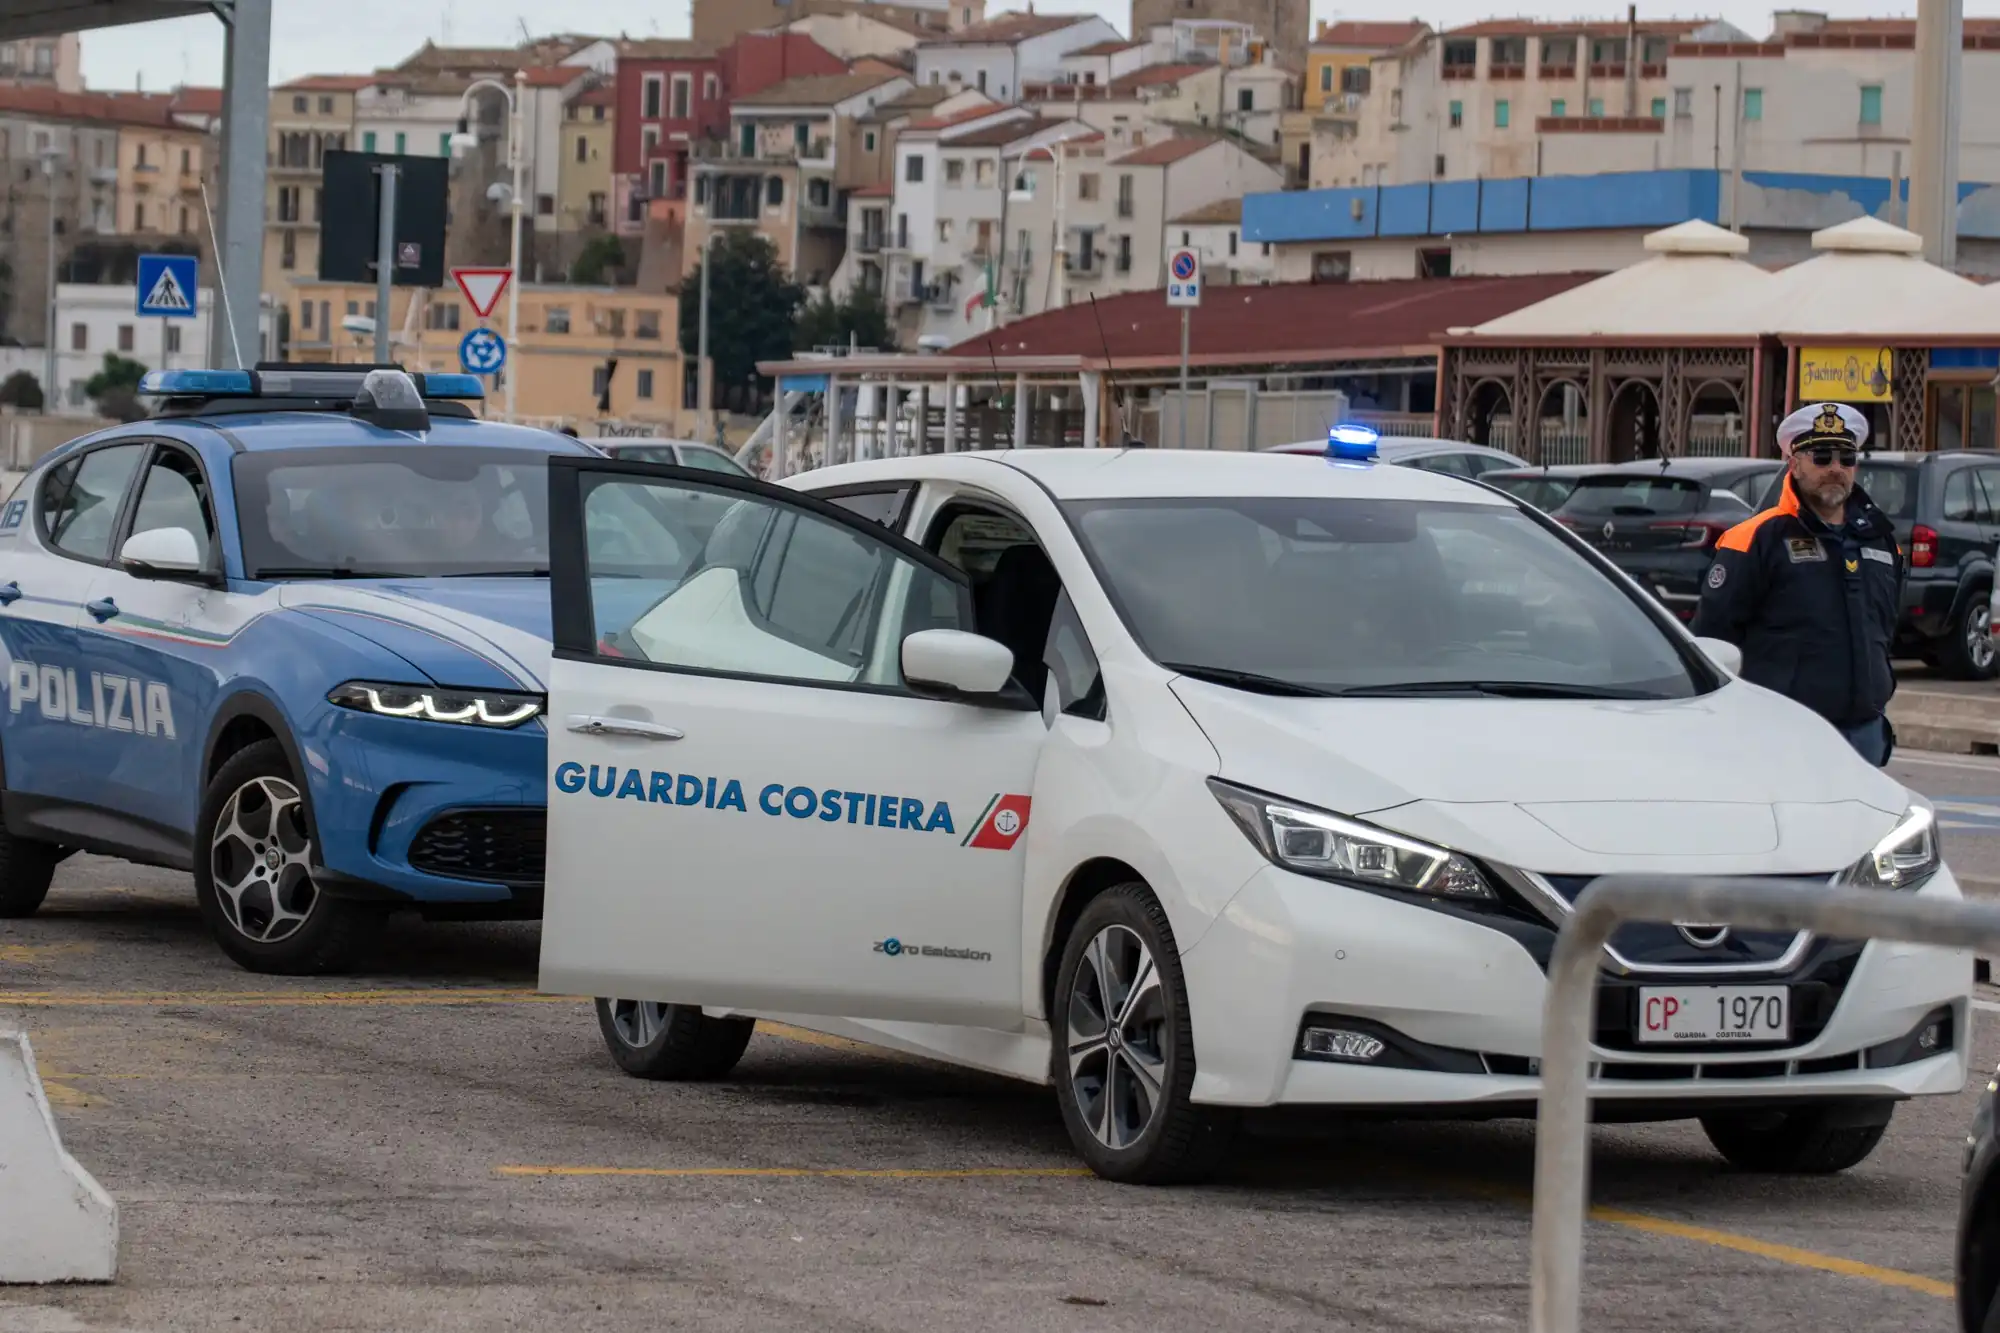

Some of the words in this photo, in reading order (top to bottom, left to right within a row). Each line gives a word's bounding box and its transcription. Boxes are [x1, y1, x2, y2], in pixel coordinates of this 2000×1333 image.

[9, 659, 177, 740] POLIZIA
[554, 761, 747, 812] GUARDIA
[759, 783, 956, 834] COSTIERA
[1646, 996, 1679, 1031] CP
[1717, 996, 1782, 1030] 1970
[1673, 1031, 1707, 1039] GUARDIA
